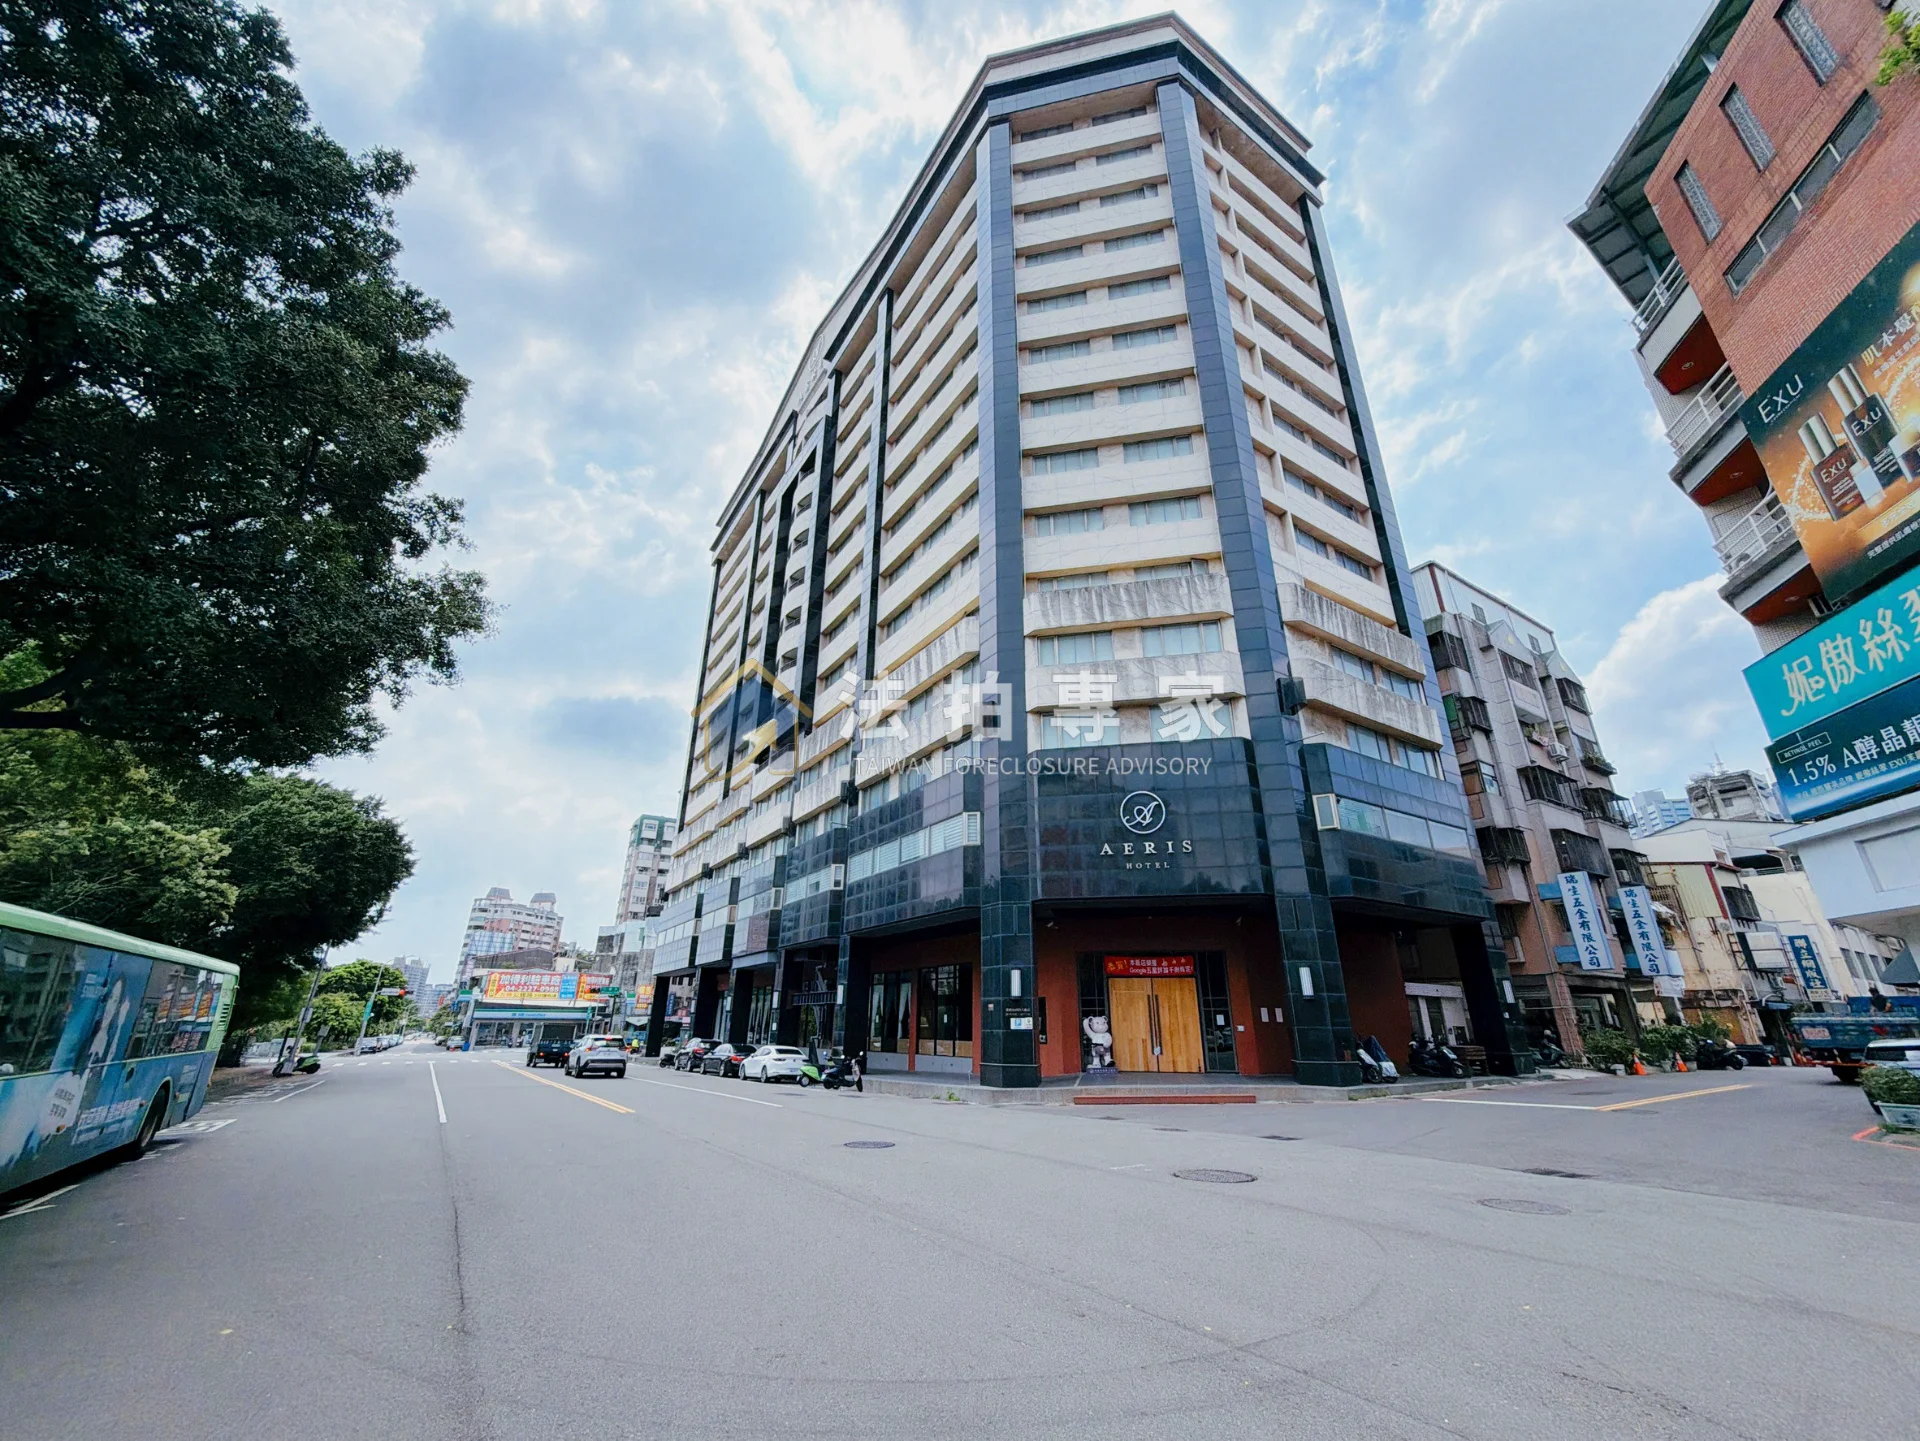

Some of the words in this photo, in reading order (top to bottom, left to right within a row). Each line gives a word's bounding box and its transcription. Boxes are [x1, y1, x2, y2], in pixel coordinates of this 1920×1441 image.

[1788, 754, 1836, 787] 1.5%
[1100, 840, 1192, 855] AERIS
[1564, 874, 1601, 968] 瑞生五金有限公司
[1624, 888, 1661, 975] 瑞生五金有限公司
